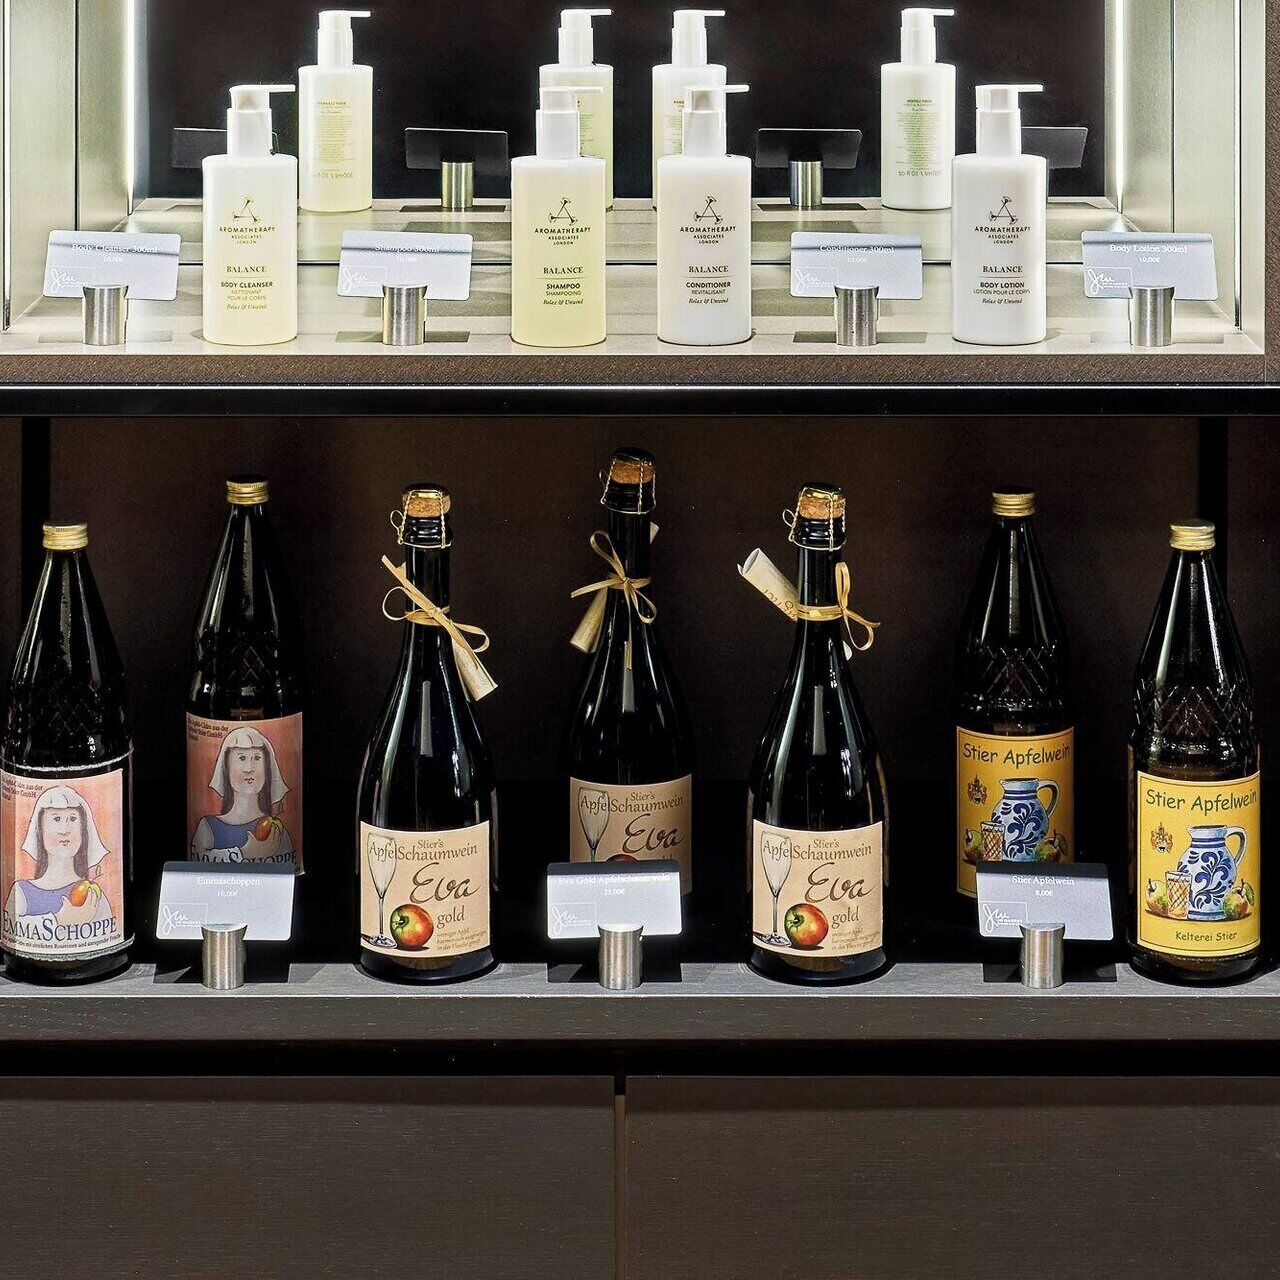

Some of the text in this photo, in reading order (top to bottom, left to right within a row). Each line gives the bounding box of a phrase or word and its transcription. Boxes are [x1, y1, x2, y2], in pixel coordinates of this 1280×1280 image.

[1109, 244, 1188, 254] Body Lotion 300ml
[226, 265, 267, 273] BALANCE
[688, 265, 729, 273] BALANCE
[982, 265, 1023, 273] BALANCE
[685, 281, 731, 289] CONDITIONER
[963, 742, 1071, 769] Stier Apfelwein
[1145, 789, 1258, 816] Stier Apfelwein
[622, 813, 684, 853] Eva
[197, 876, 261, 888] Emmaschoppen
[409, 862, 480, 904] Eva
[804, 862, 876, 903] Eva
[1011, 875, 1075, 887] Stier Apfelwein
[436, 905, 465, 929] gold
[831, 906, 859, 929] gold
[1175, 930, 1238, 942] Kelterei Stier
